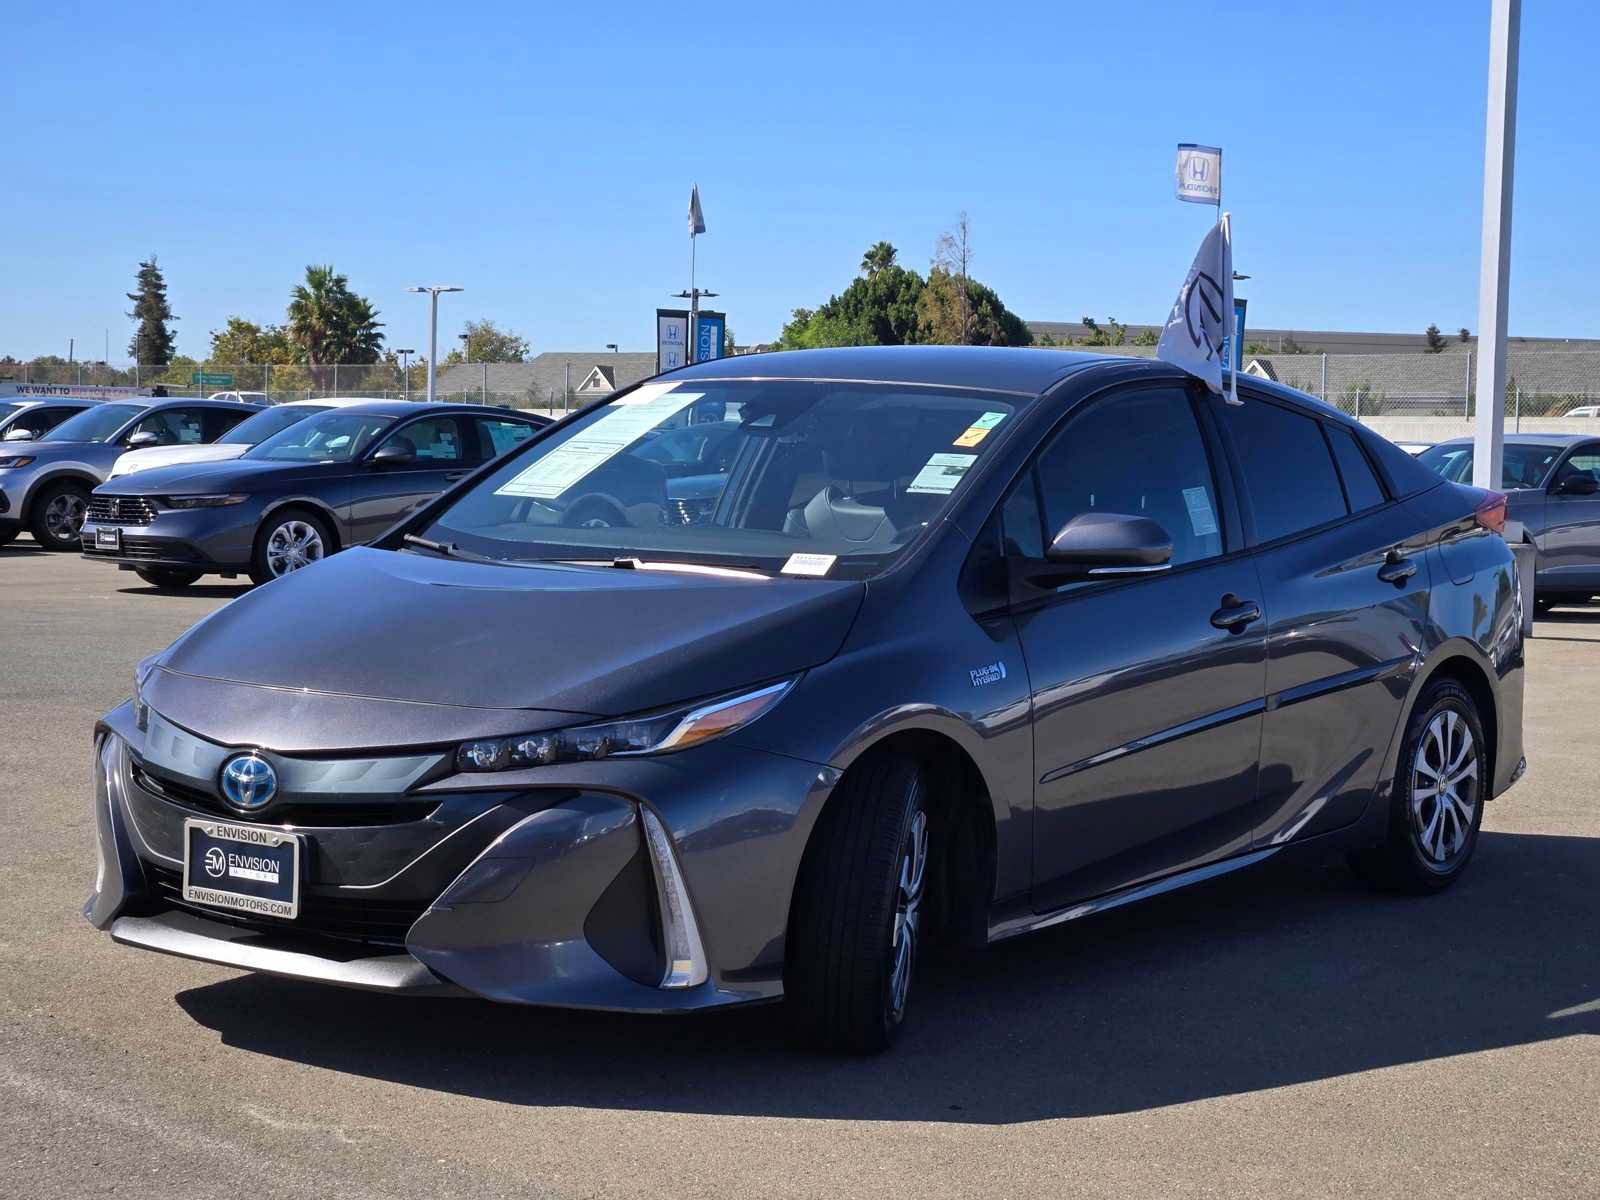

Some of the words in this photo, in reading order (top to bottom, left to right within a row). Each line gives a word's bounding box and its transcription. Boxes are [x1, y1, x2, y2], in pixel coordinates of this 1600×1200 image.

[16, 385, 31, 394] WE
[31, 386, 59, 395] WANT
[58, 387, 71, 395] TO
[217, 825, 267, 843] ENVISION
[228, 853, 280, 873] ENVISION
[188, 889, 292, 915] ENVISIONMOTORS.COM
